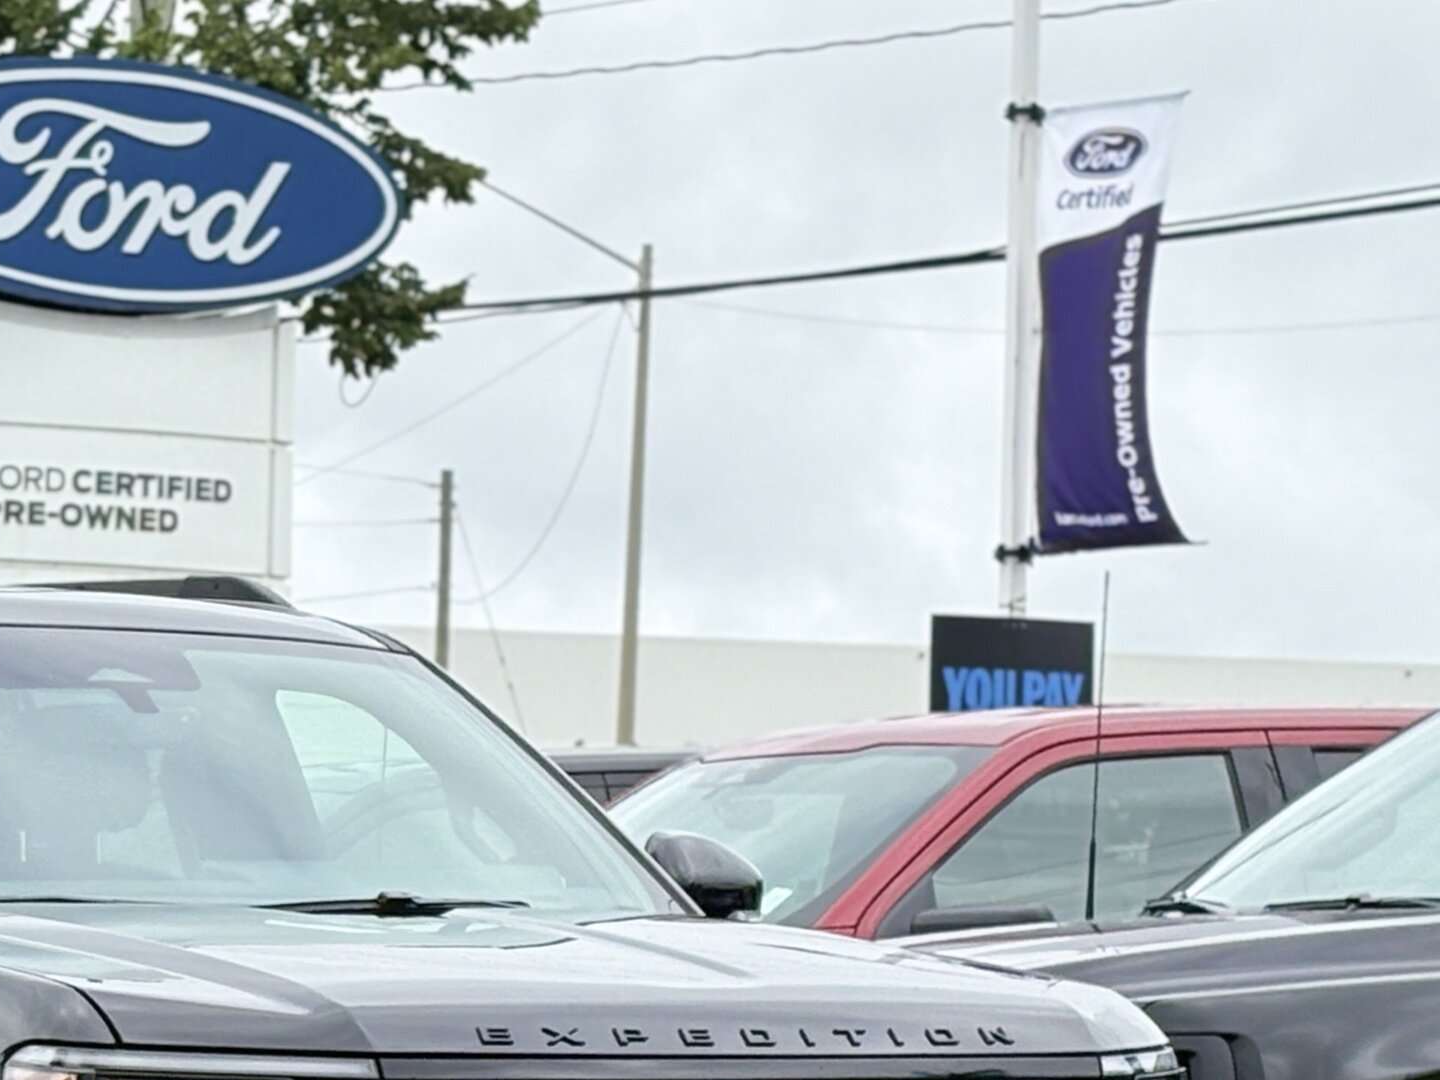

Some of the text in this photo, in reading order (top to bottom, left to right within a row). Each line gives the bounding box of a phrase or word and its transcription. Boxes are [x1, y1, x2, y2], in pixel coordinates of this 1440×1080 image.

[1074, 135, 1137, 170] Ford
[1109, 233, 1158, 523] Pre-Owned Vehicles
[71, 469, 232, 503] CERTIFIED
[1022, 670, 1084, 706] PAY
[476, 1026, 1015, 1048] EXPEDITION
